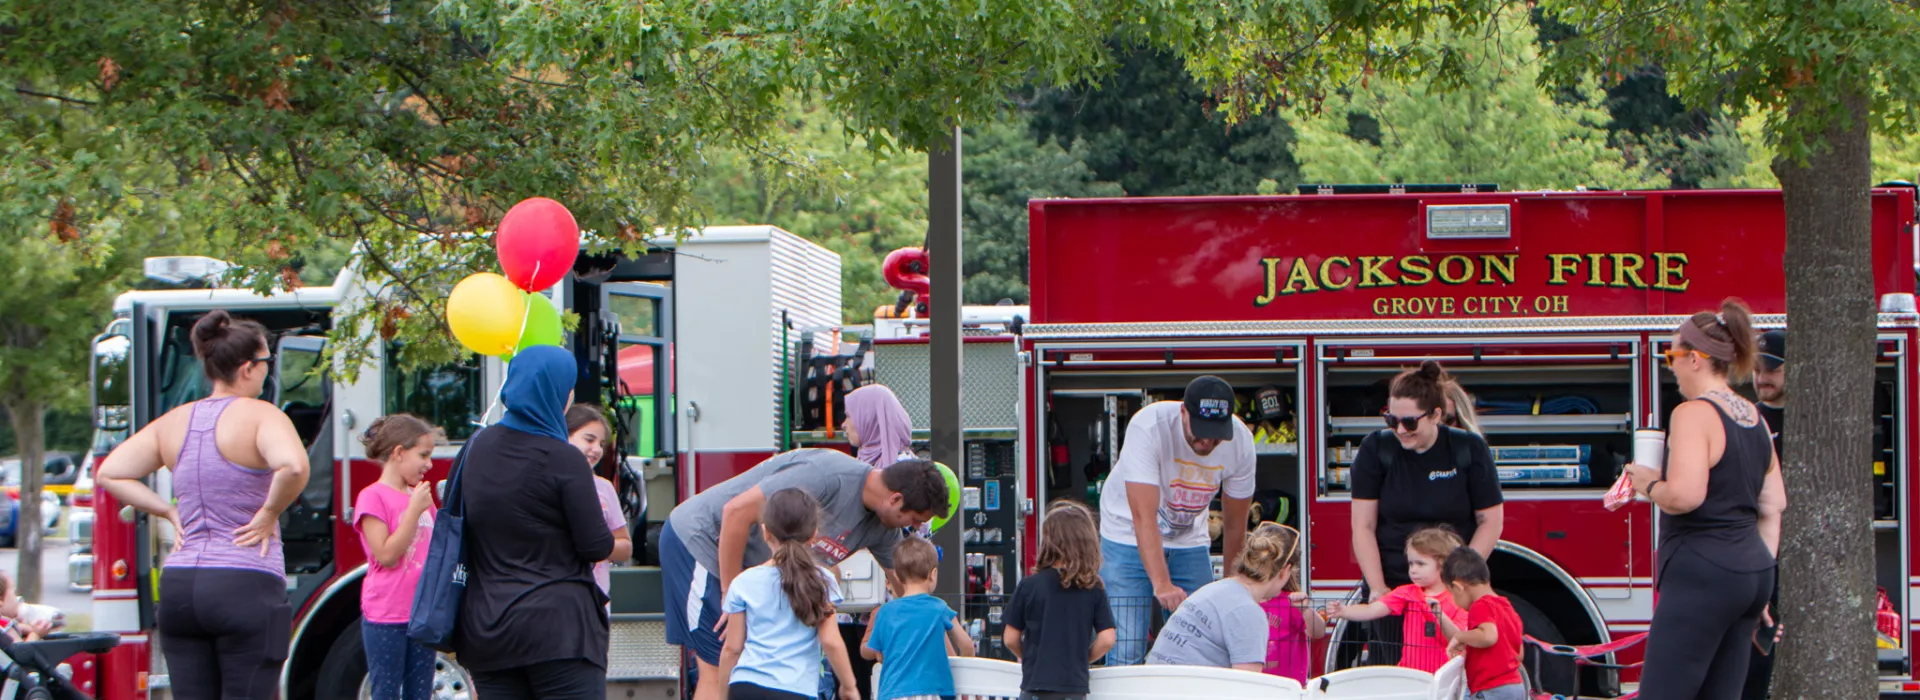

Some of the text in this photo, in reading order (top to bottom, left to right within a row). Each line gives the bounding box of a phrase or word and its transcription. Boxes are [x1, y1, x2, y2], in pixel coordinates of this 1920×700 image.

[1253, 252, 1690, 307] JACKSON FIRE
[1372, 295, 1569, 315] GROVE CITY, OH
[1261, 397, 1280, 410] 201
